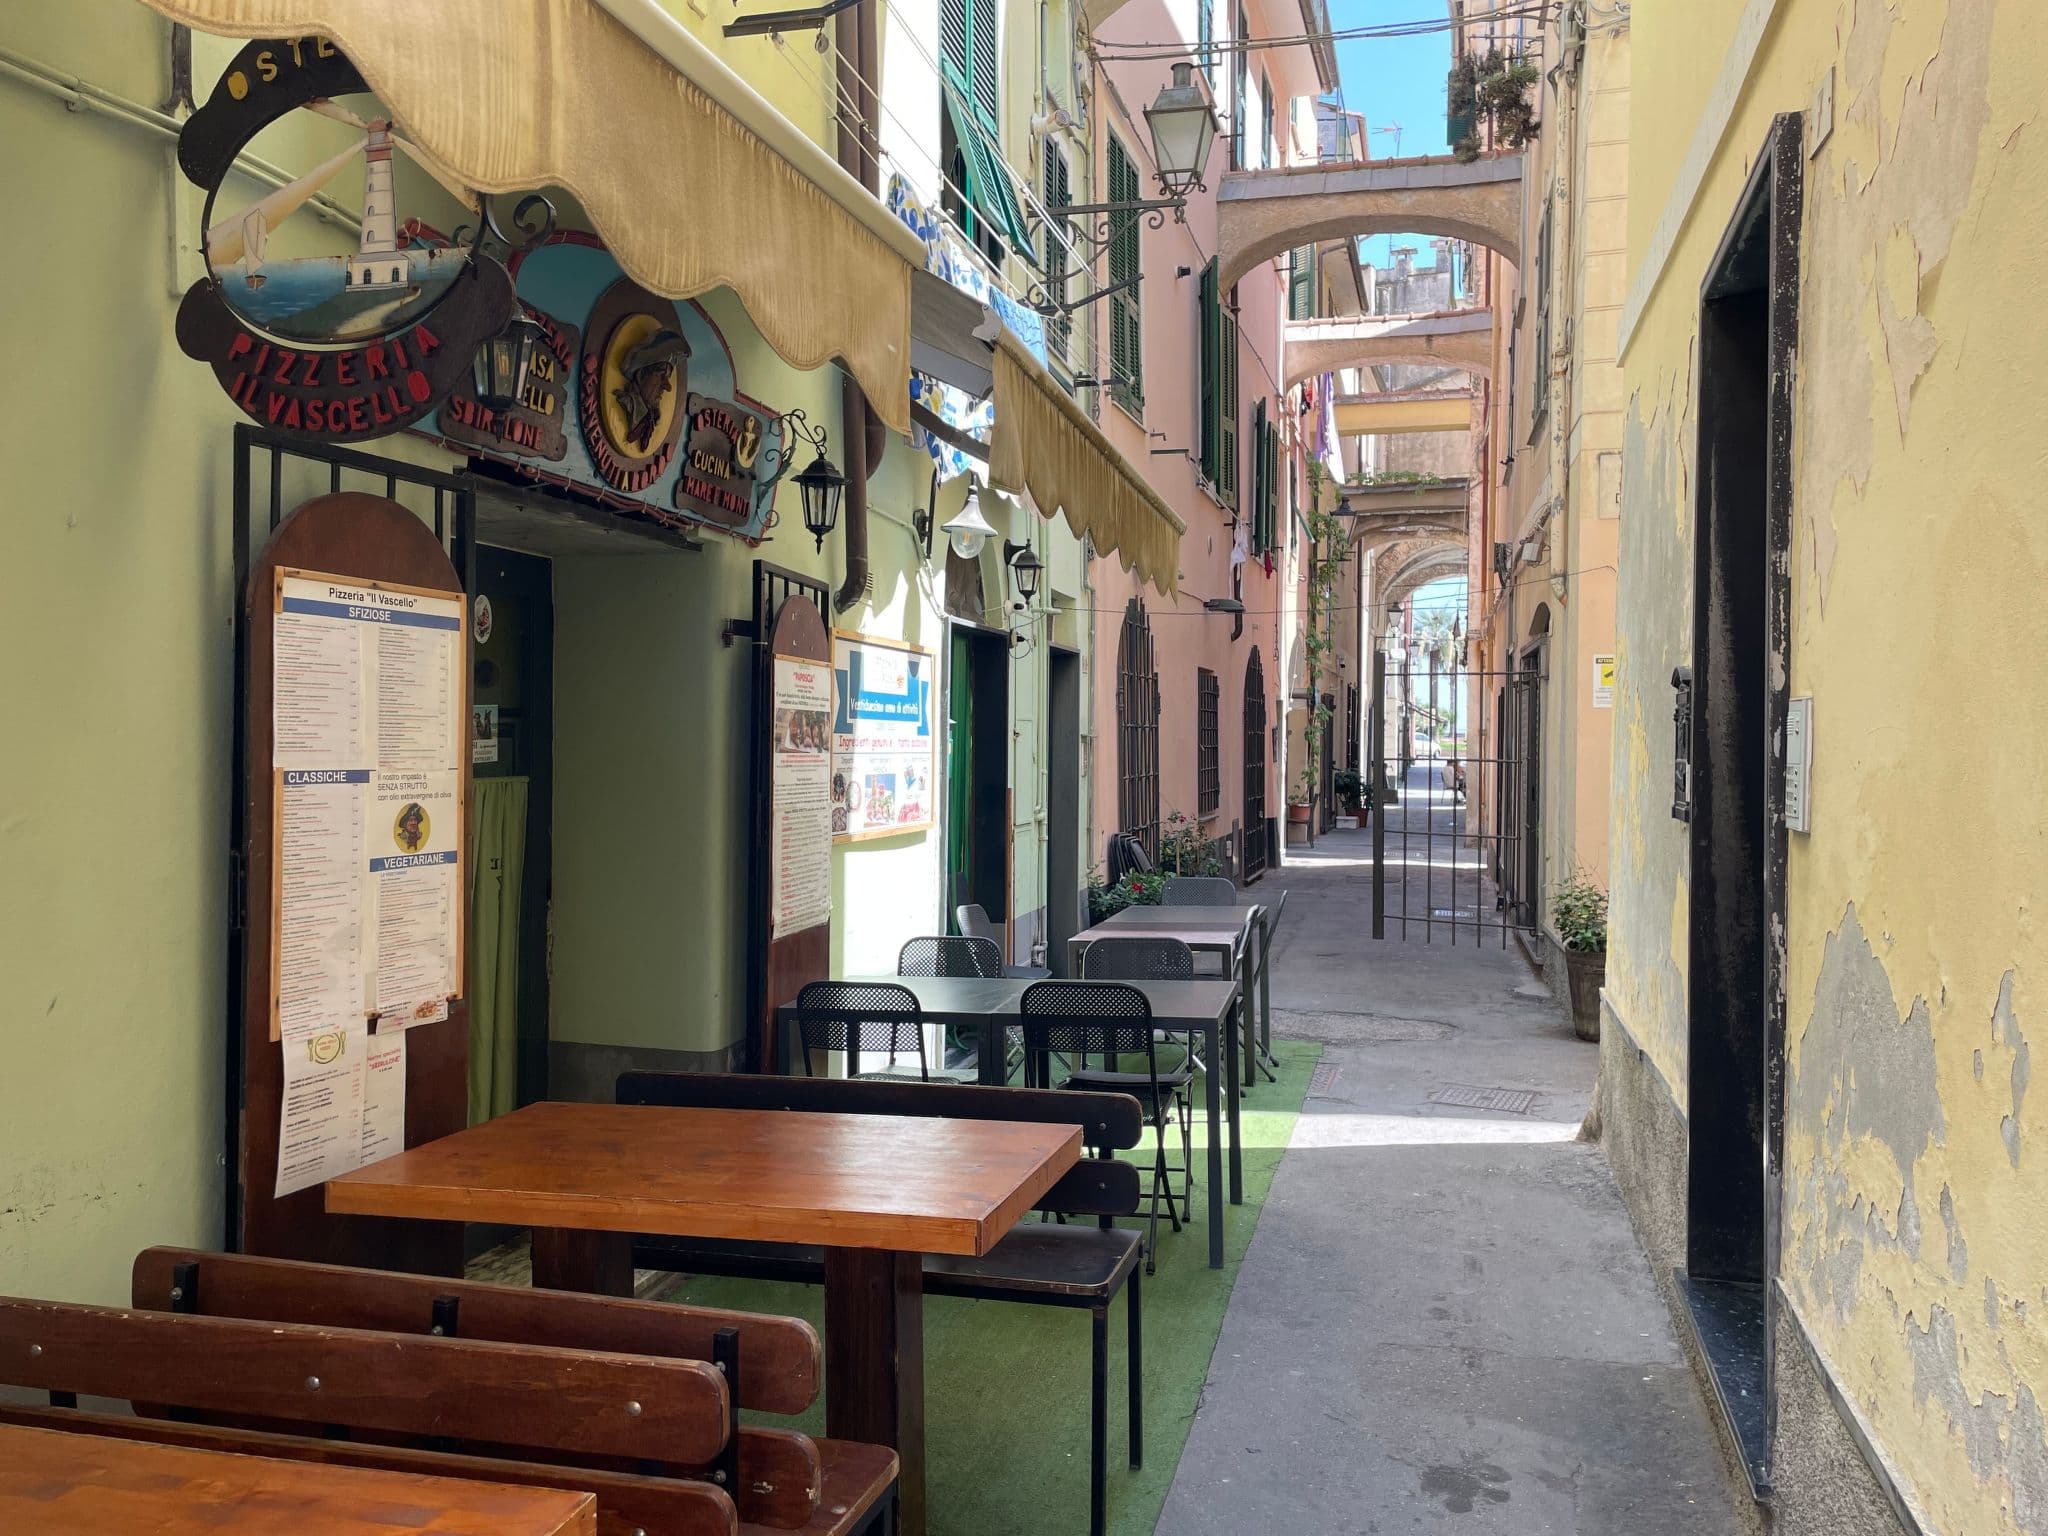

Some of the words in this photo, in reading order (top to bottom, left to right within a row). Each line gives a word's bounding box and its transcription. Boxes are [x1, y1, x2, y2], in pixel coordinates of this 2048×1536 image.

[228, 324, 440, 386] PIZZERIA
[230, 371, 258, 414] IL
[268, 370, 431, 432] VASCELLO
[451, 395, 546, 450] SBIRLONE
[696, 408, 739, 445] OSTERIA
[694, 449, 730, 481] CUCINA
[686, 476, 713, 504] MARE
[328, 587, 365, 602] Pizzeria
[378, 594, 418, 608] Vascello"
[348, 606, 392, 622] SFIZIOSE
[287, 771, 348, 783] CLASSICHE
[377, 783, 398, 791] SENZA
[400, 781, 428, 791] STRUTTO
[383, 853, 445, 869] VEGETARIANE
